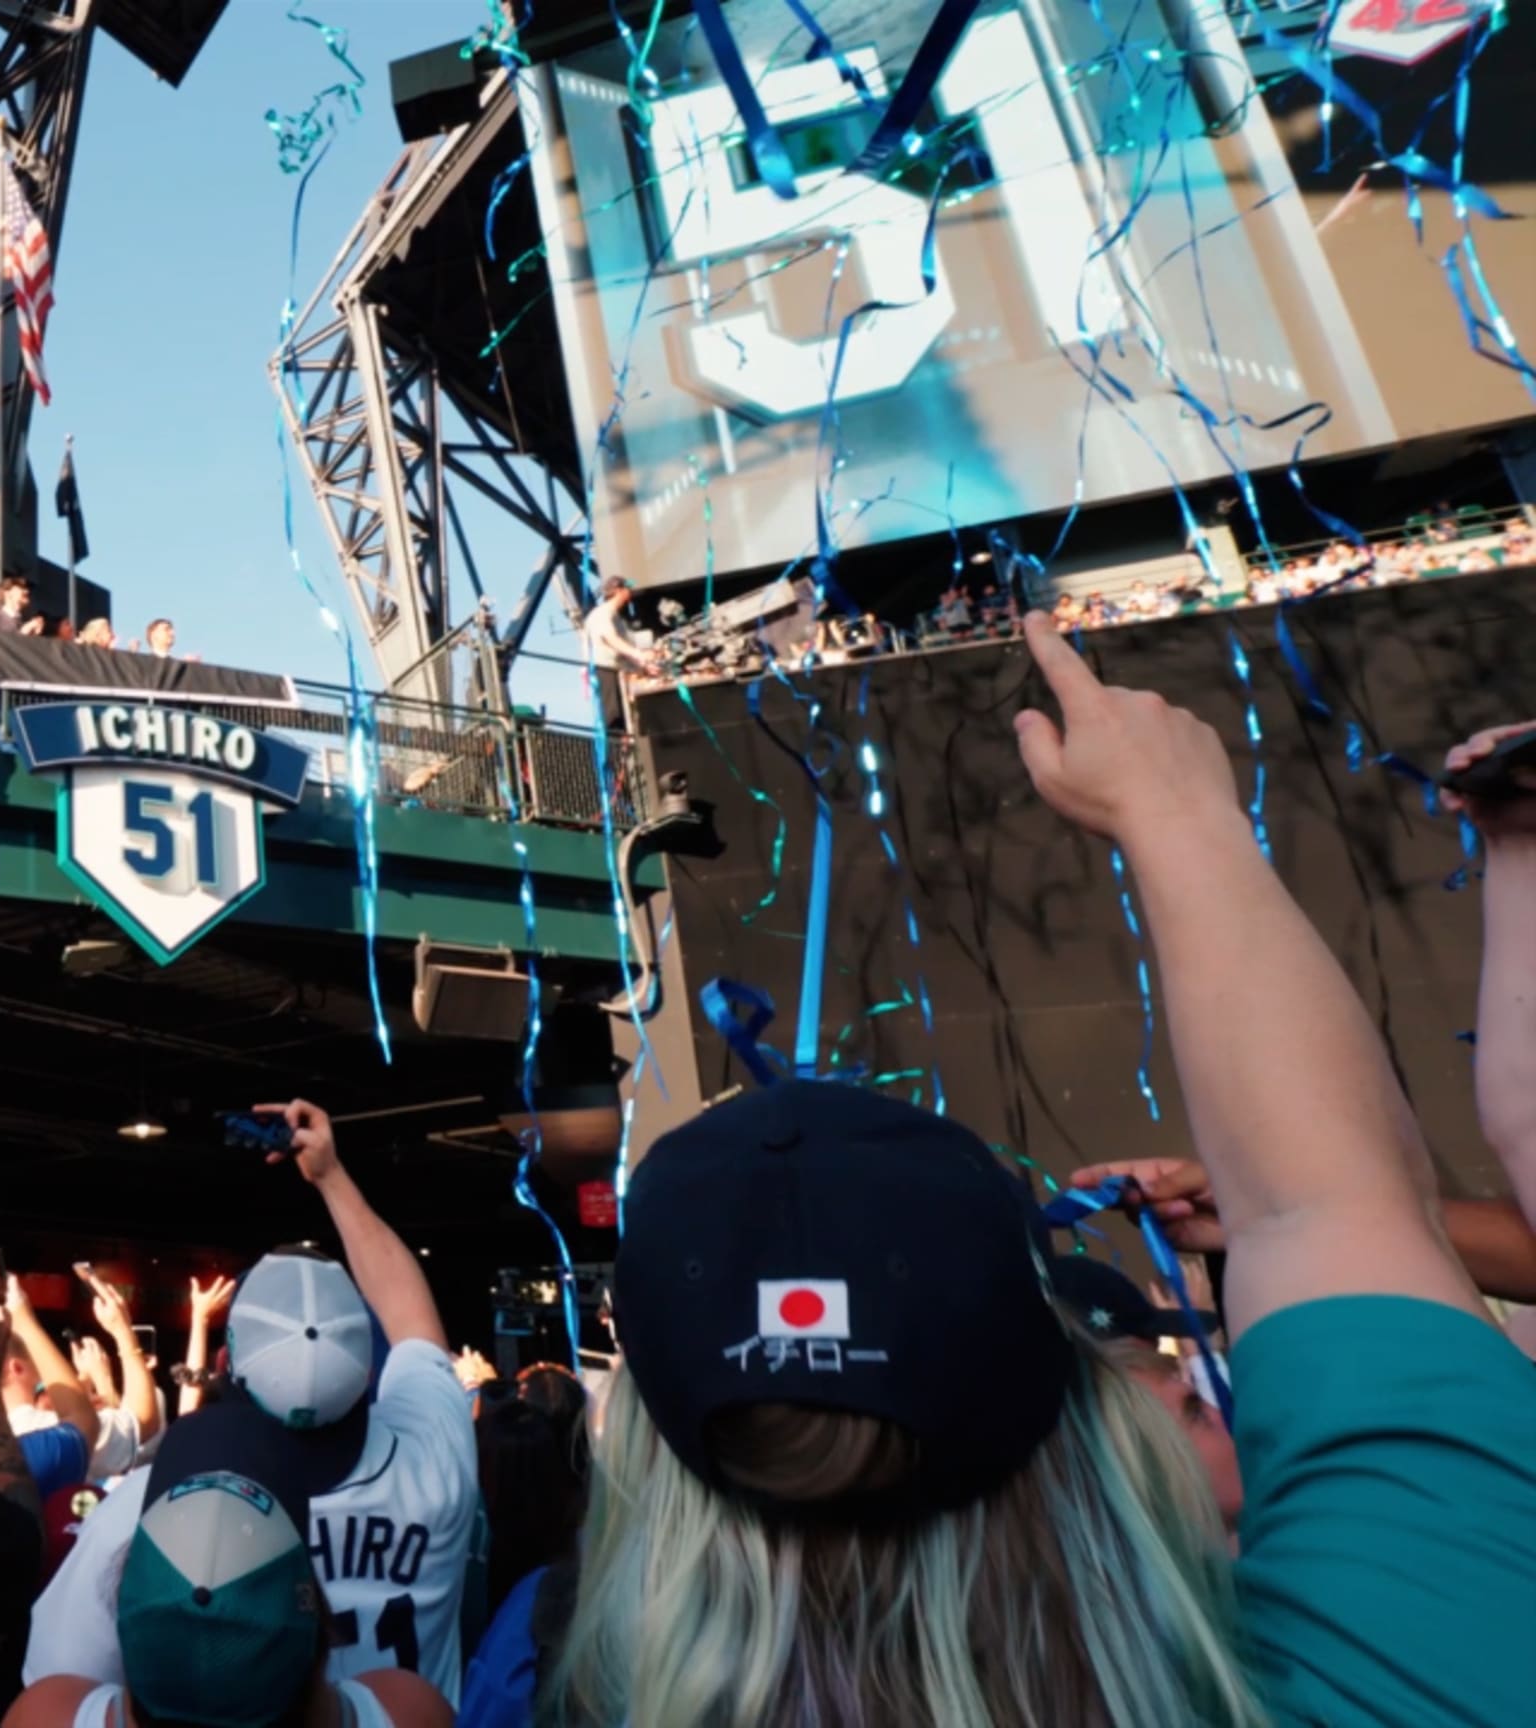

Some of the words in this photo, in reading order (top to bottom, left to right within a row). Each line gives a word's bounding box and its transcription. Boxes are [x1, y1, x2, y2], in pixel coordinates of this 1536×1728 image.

[650, 8, 1132, 415] 51
[76, 704, 257, 771] ICHIRO
[120, 777, 219, 886] 51
[721, 1333, 889, 1374] イチロー
